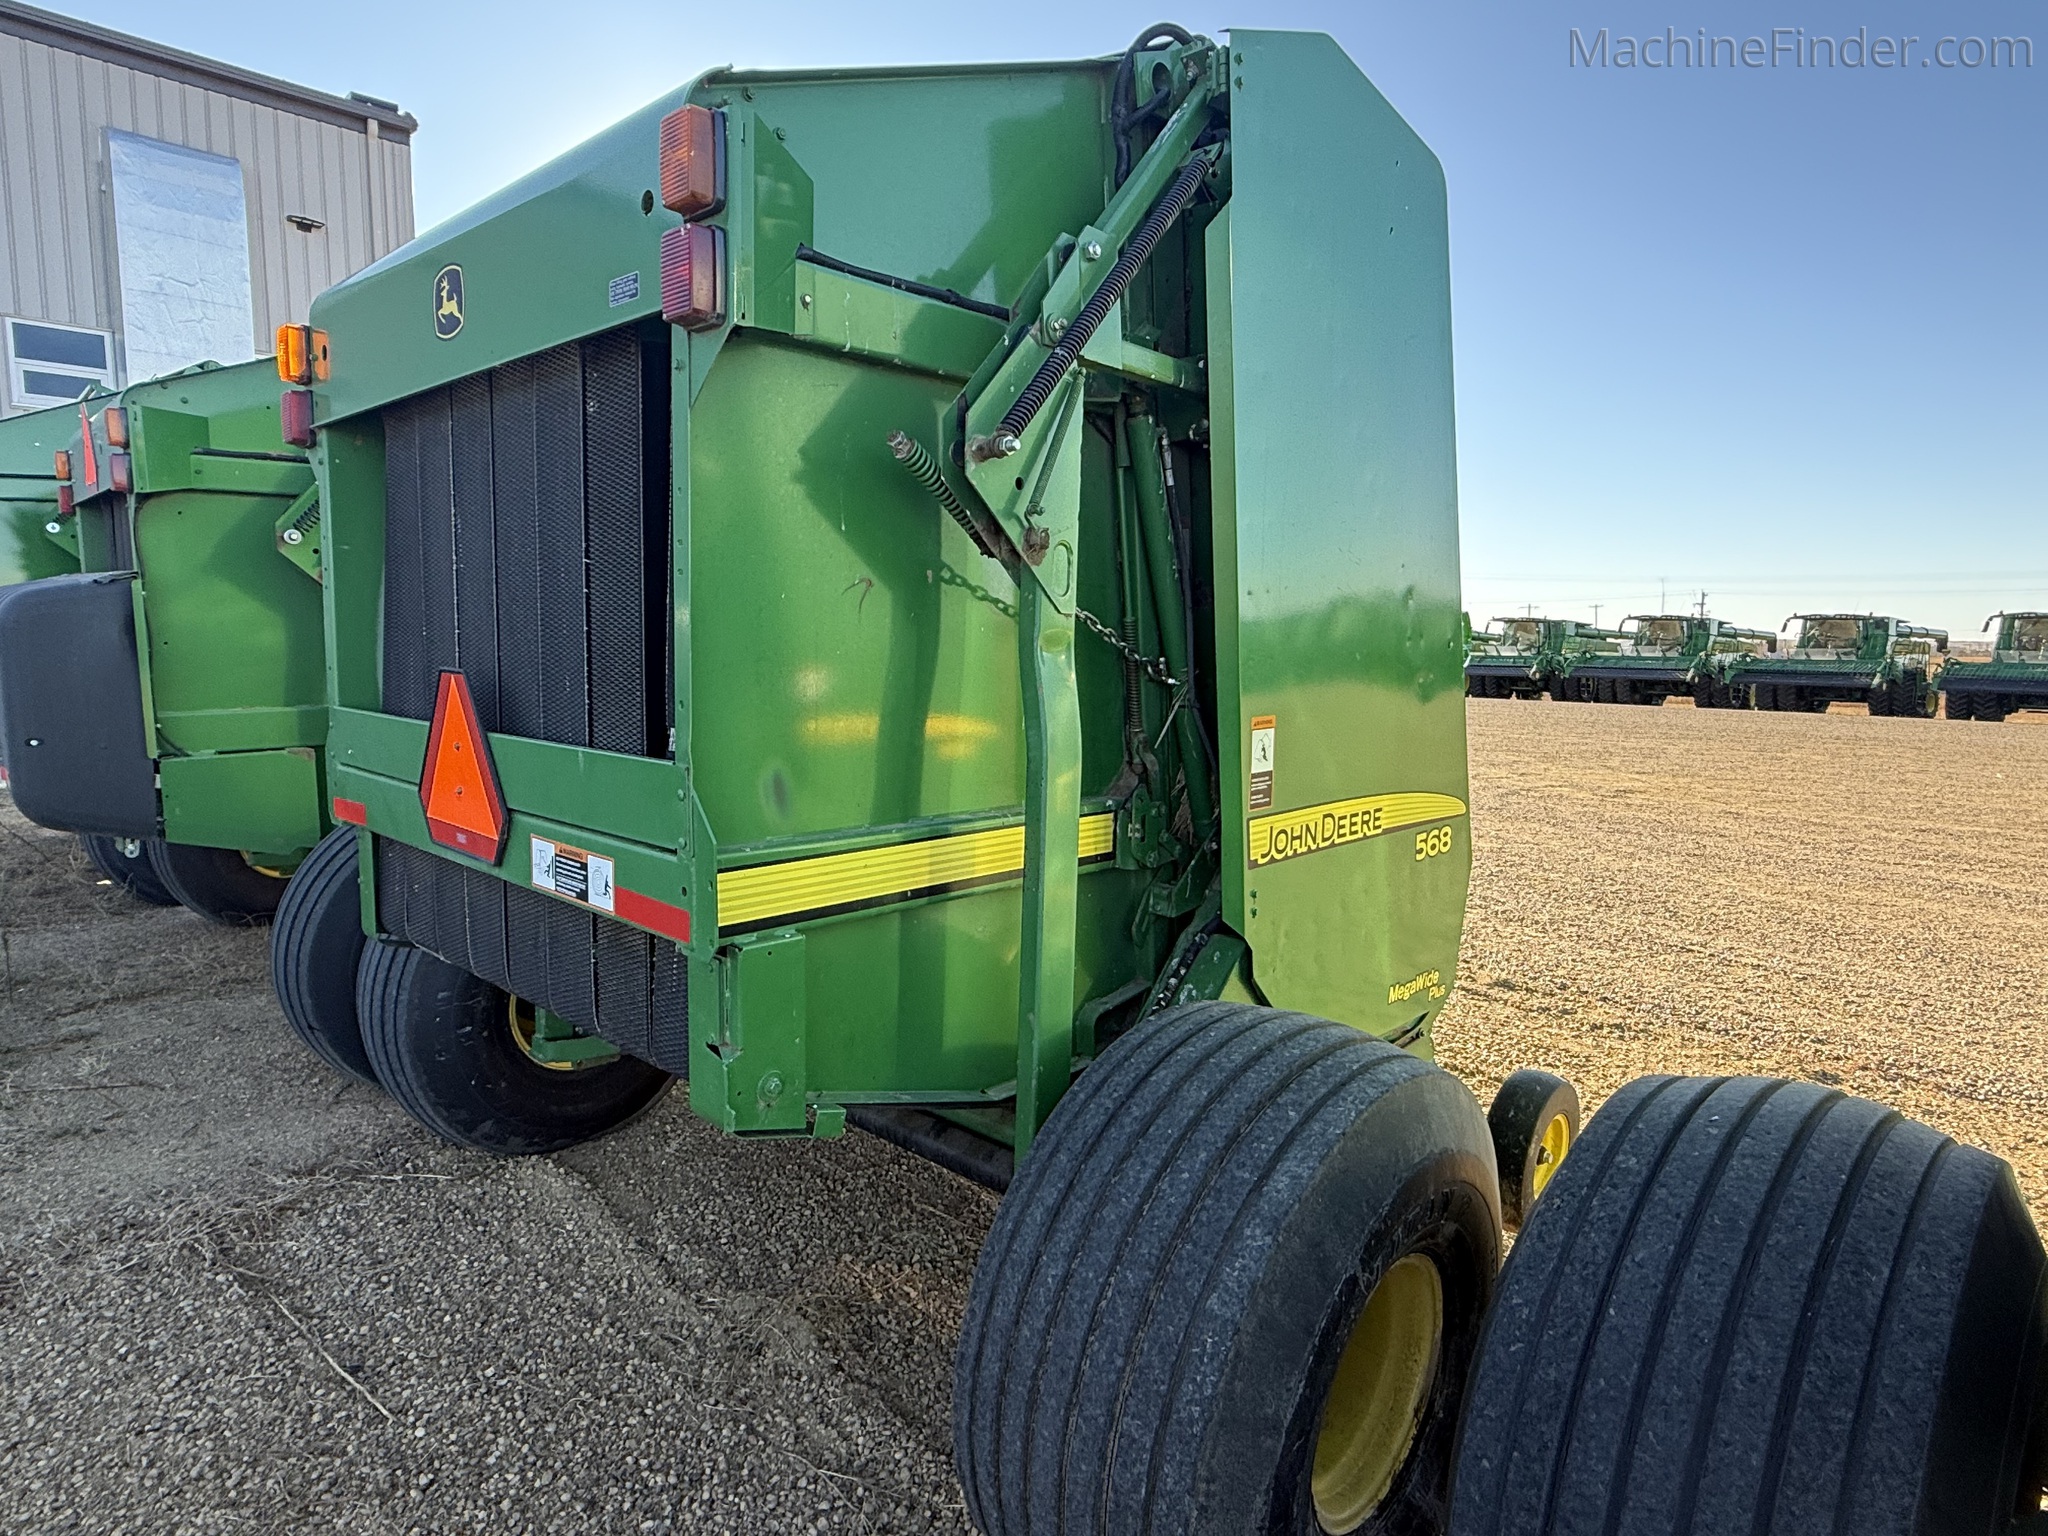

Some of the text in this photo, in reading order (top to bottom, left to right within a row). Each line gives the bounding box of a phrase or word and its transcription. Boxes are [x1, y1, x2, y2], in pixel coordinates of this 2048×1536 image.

[1260, 807, 1383, 860] JOHN DEERE
[1415, 826, 1452, 861] 568
[1388, 969, 1440, 1004] MegaWide
[1428, 984, 1446, 1002] Plus
